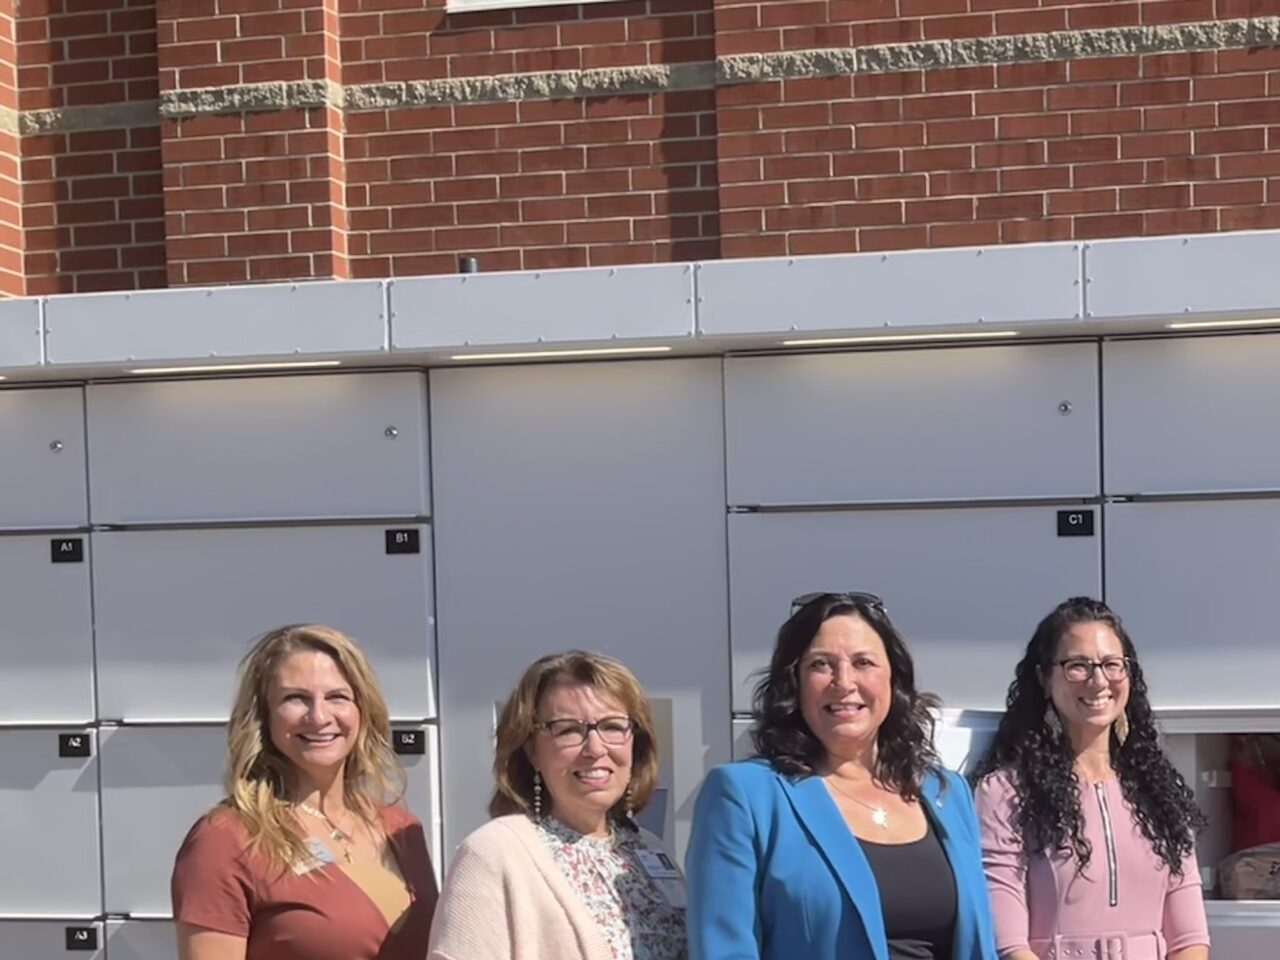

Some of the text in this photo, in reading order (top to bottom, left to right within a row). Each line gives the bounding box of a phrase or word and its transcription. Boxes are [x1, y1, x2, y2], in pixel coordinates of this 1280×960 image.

[1068, 514, 1083, 526] C1
[395, 532, 409, 544] B1
[60, 542, 73, 553] A1
[68, 737, 82, 748] A2
[74, 930, 88, 941] A3
